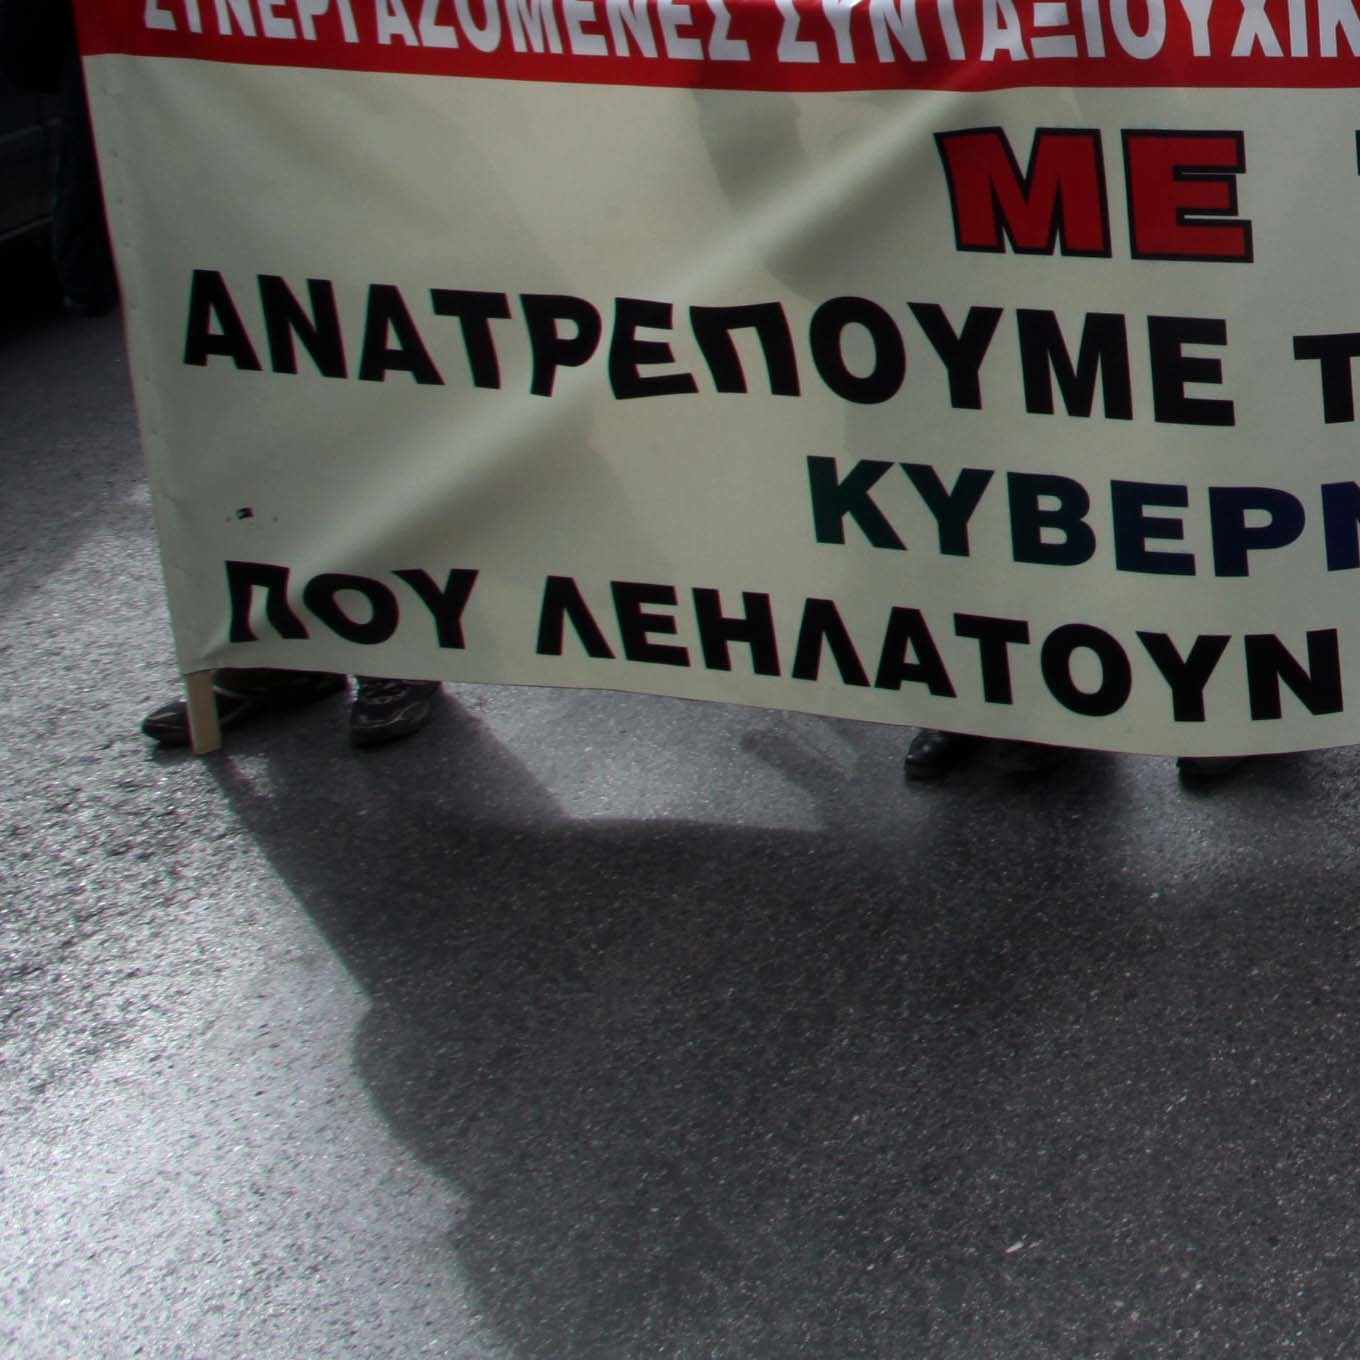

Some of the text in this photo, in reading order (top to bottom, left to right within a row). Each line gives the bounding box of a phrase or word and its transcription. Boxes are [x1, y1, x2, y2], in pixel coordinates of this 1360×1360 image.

[933, 126, 1255, 265] ΜΕ
[182, 268, 1236, 428] ΑΝΑΤΡΕΠΟΥΜΕ
[224, 559, 480, 650] ΠΟΥ
[535, 574, 1345, 723] ΛΕΗΛΑΤΟΥΝ
